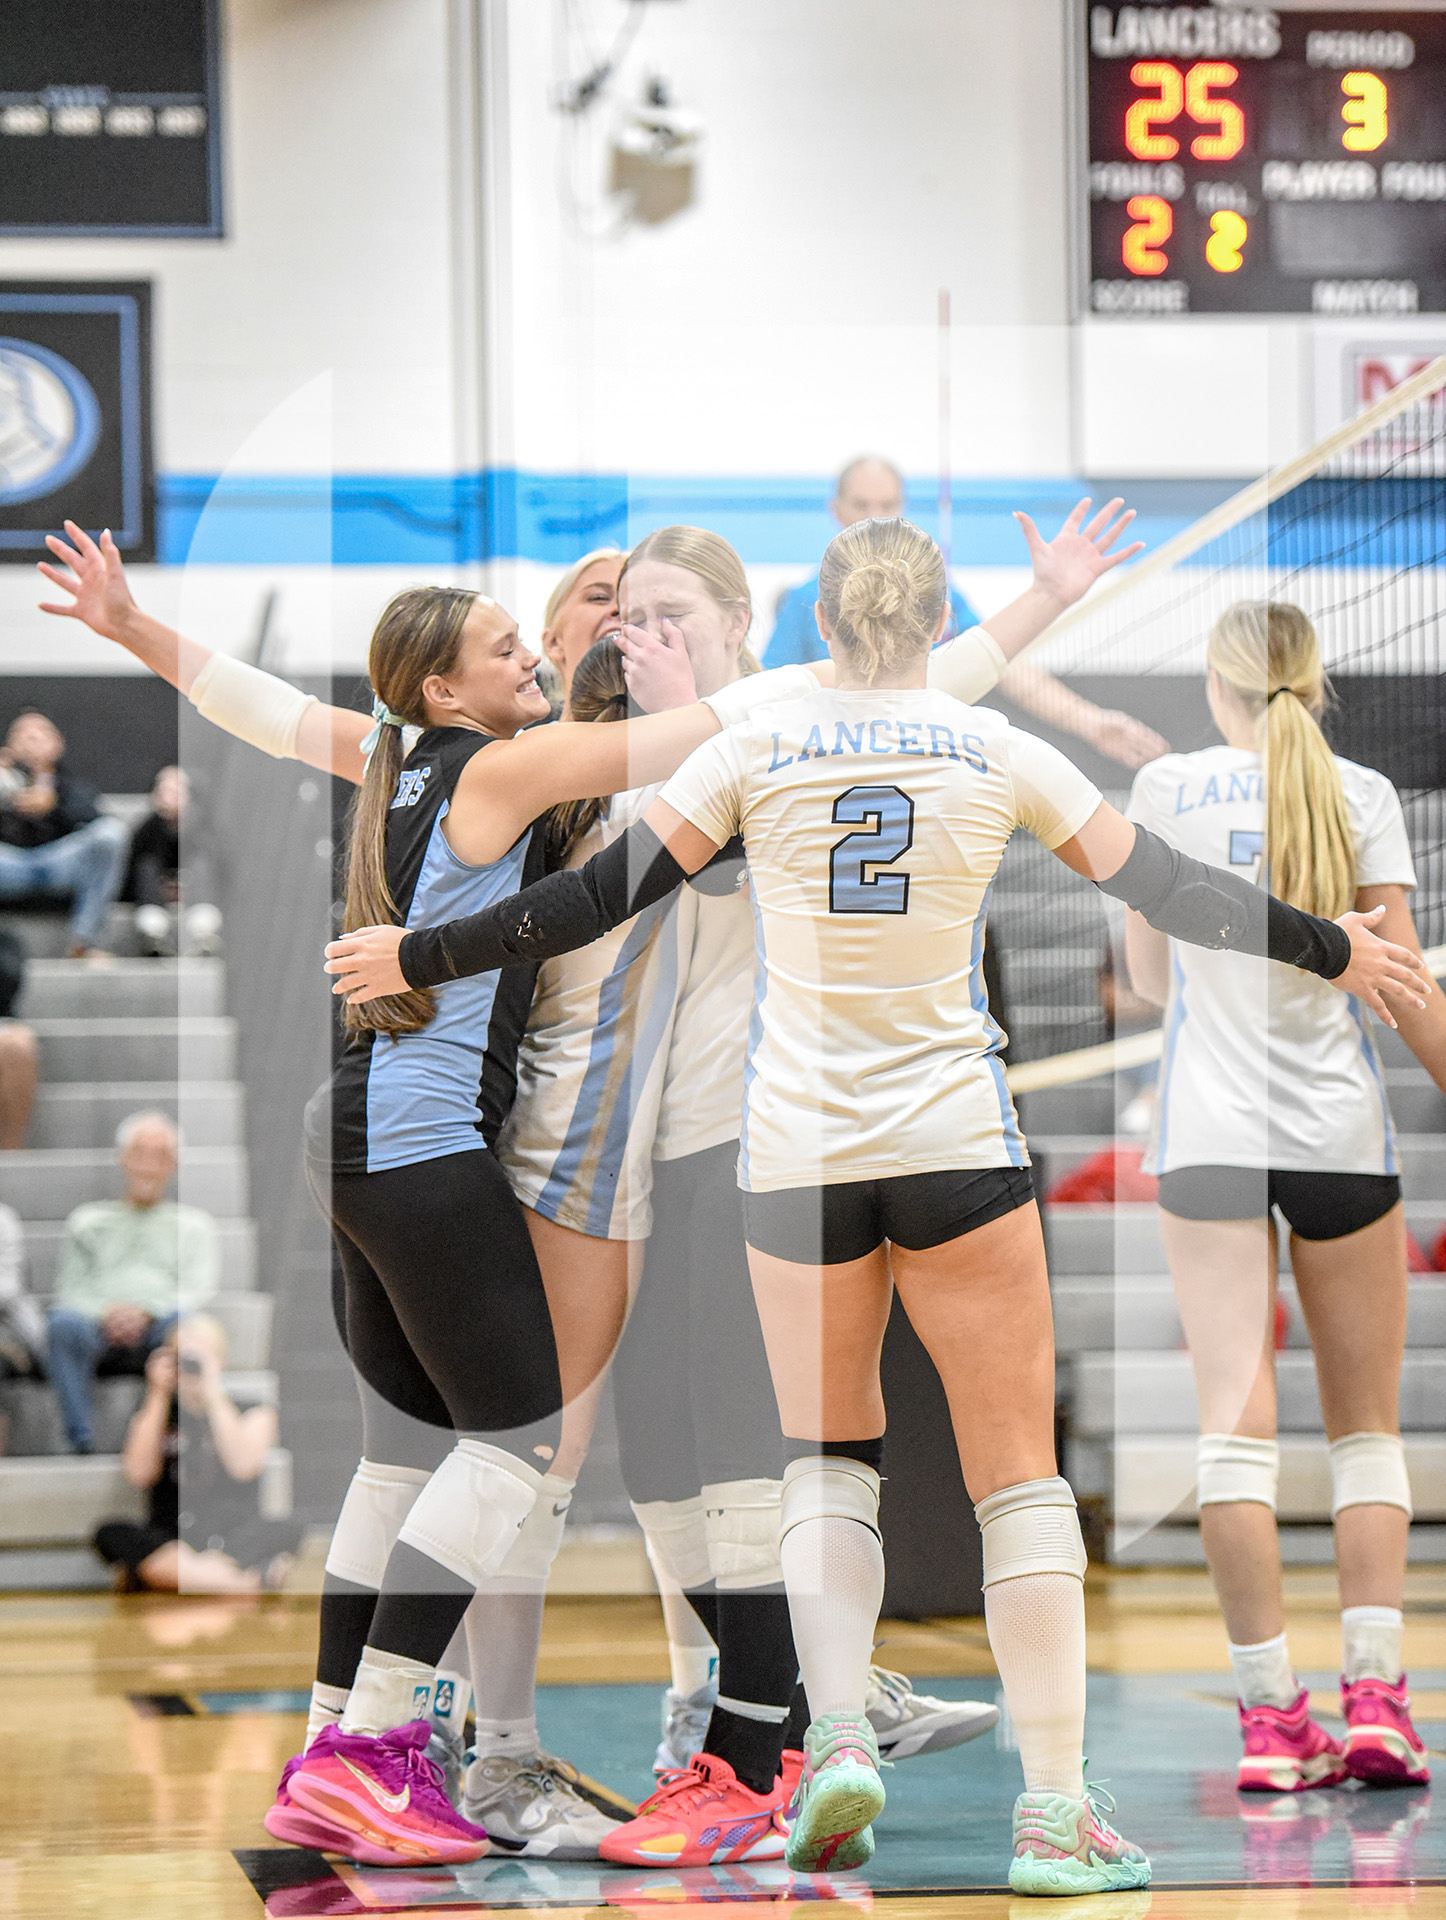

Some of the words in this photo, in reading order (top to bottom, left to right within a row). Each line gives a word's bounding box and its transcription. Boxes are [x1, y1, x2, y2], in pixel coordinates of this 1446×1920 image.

[1091, 5, 1282, 58] LANCERS
[1125, 62, 1245, 160] 25
[1341, 72, 1388, 151] 3
[1122, 195, 1173, 275] 2
[767, 720, 988, 774] LANCERS
[829, 785, 915, 914] 2
